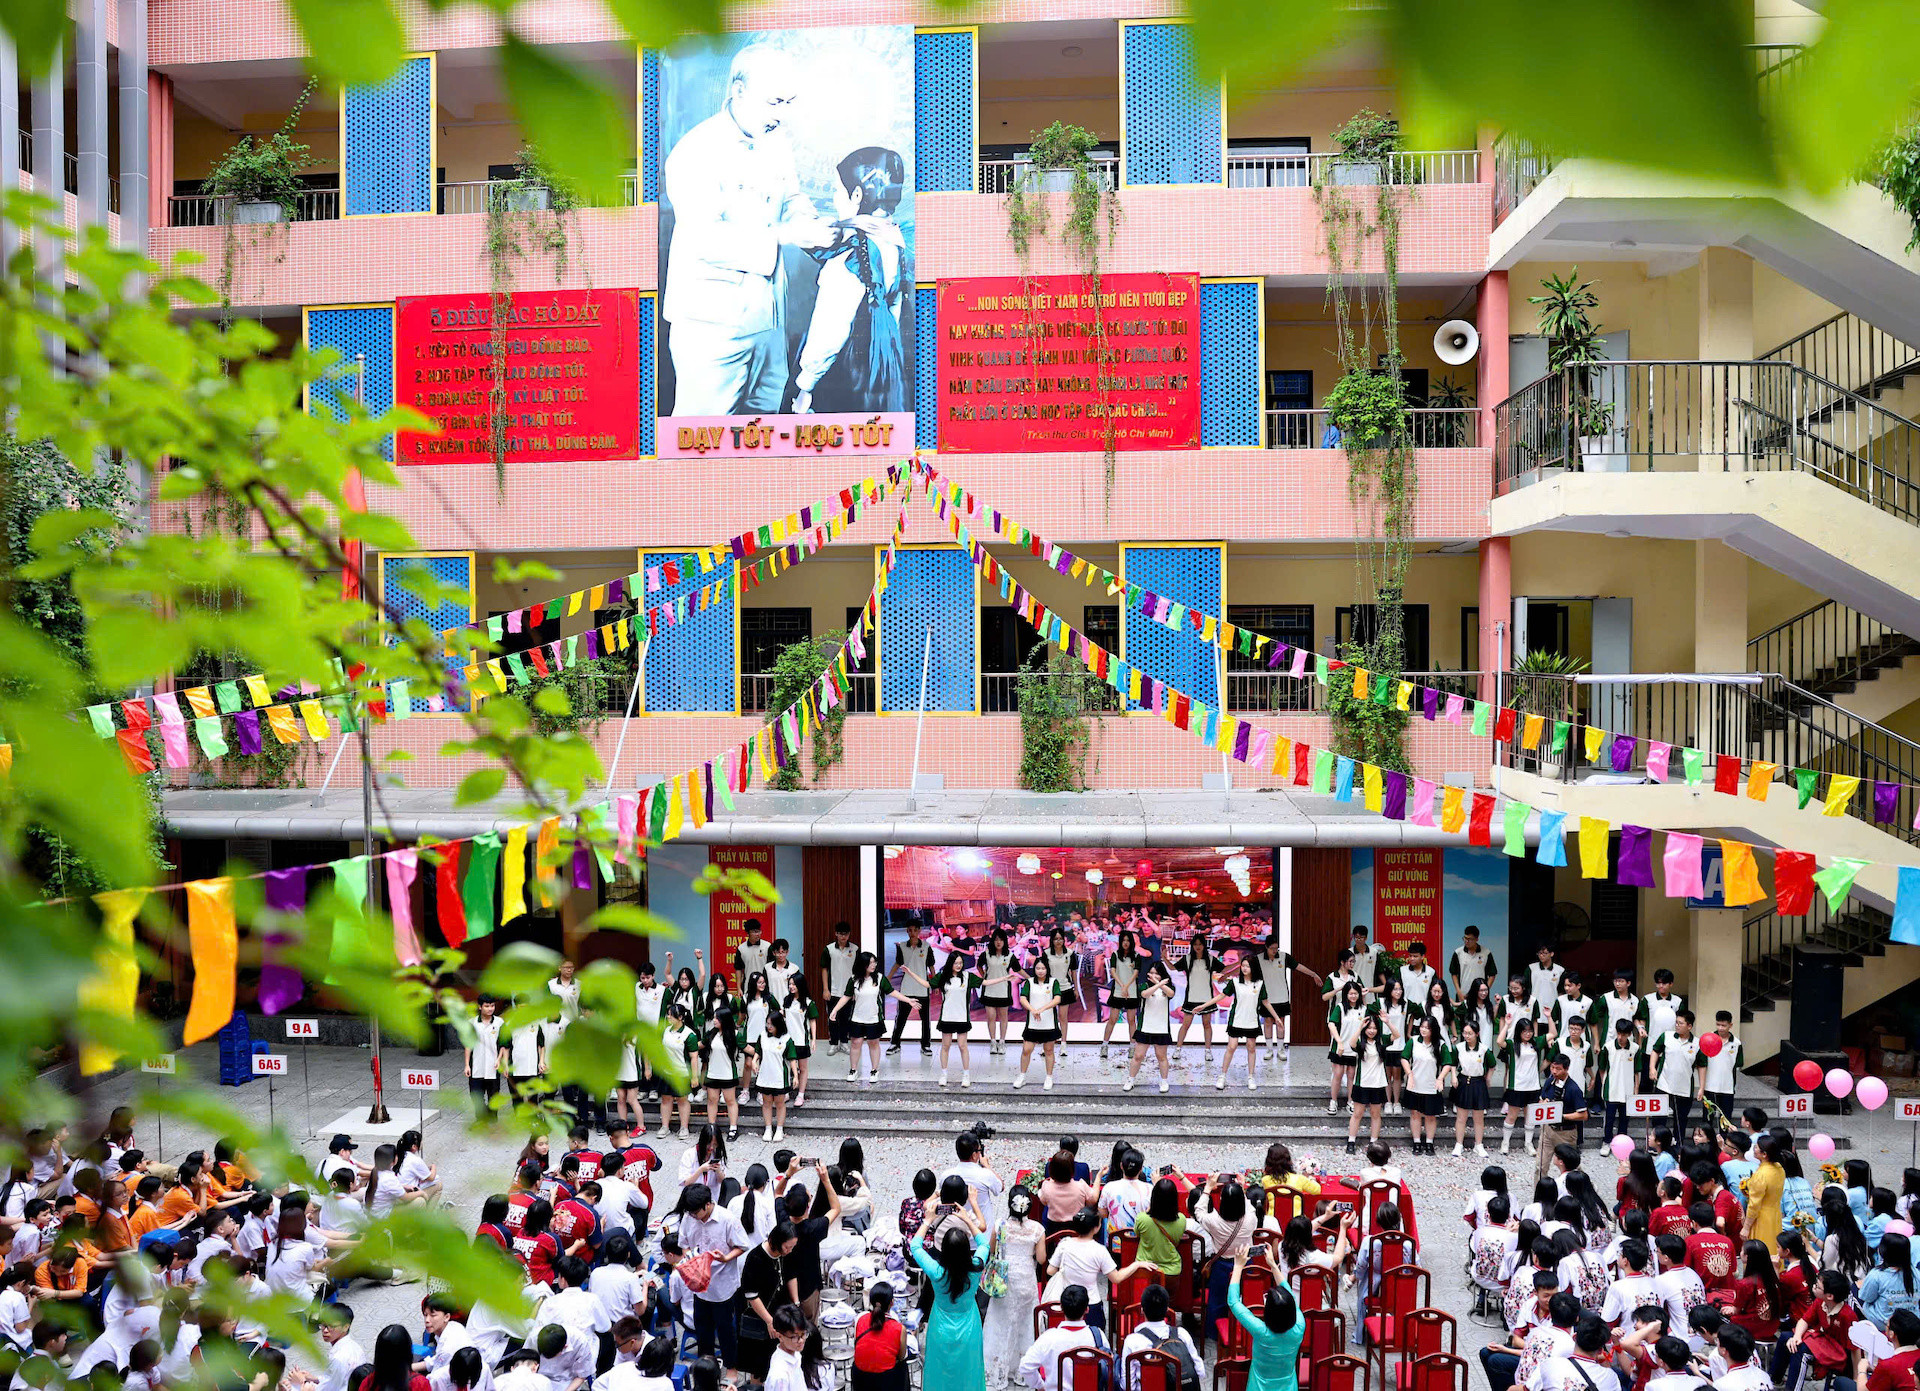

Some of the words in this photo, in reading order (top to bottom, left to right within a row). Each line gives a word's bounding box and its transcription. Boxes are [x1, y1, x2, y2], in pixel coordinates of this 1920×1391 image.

[431, 307, 442, 326] 5
[446, 300, 490, 326] ĐIỀU
[534, 297, 560, 323] HỒ
[565, 304, 600, 324] DẠY
[1001, 292, 1028, 311] SÔNG
[1031, 292, 1052, 313] VIỆT
[1055, 294, 1078, 309] NAM
[1119, 289, 1140, 308] NÊN
[1168, 291, 1188, 309] ĐẸP
[949, 324, 968, 340] HAY
[1057, 320, 1078, 340] VIỆT
[1107, 318, 1121, 337] CÓ
[415, 345, 426, 358] 1.
[428, 341, 450, 358] YÊU
[506, 338, 528, 354] YÊU
[949, 351, 974, 367] VINH
[977, 350, 1012, 367] QUANG
[1062, 349, 1079, 365] VAI
[1161, 340, 1188, 364] QUỐC
[415, 370, 426, 383] 2.
[428, 368, 451, 386] HỌC
[454, 365, 476, 384] TẬP
[504, 366, 527, 380] LAO
[529, 362, 561, 382] ĐỘNG
[949, 377, 973, 395] NĂM
[976, 376, 1002, 394] CHÂU
[1036, 378, 1054, 393] HAY
[1168, 373, 1188, 393] MỘT
[415, 393, 426, 407] 3.
[463, 386, 484, 405] KẾT
[532, 386, 559, 405] LUẬT
[563, 385, 588, 402] TỐT.
[521, 410, 549, 429] THẬT
[1011, 404, 1038, 419] CÔNG
[1041, 404, 1061, 421] HỌC
[1064, 402, 1082, 421] TẬP
[1108, 399, 1128, 418] CÁC
[416, 441, 426, 454] 5.
[428, 437, 464, 454] KHIÊM
[556, 433, 587, 451] DŨNG
[678, 427, 725, 453] DẠY
[731, 418, 775, 448] TỐT
[795, 424, 844, 452] HỌC
[849, 416, 894, 446] TỐT
[1419, 887, 1436, 899] HUY
[1411, 902, 1432, 919] HIỆU
[726, 919, 740, 931] THI
[258, 1059, 281, 1070] 6A5
[408, 1073, 433, 1086] 6A6
